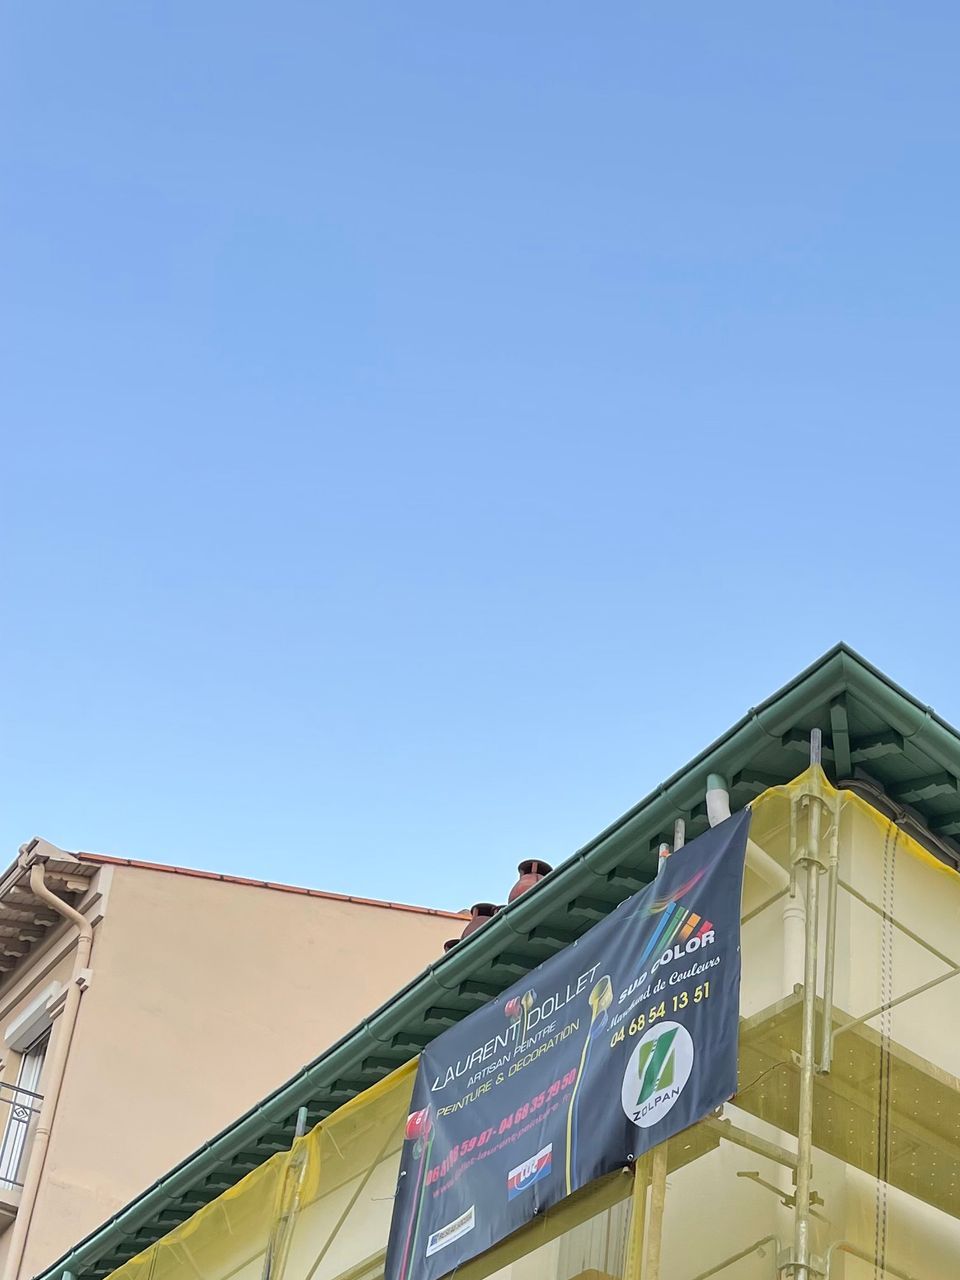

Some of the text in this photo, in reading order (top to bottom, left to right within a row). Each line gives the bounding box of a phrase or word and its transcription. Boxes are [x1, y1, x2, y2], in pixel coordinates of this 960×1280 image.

[618, 930, 715, 1004] SUD COLOR
[653, 979, 666, 995] de
[669, 956, 721, 986] Couleurs
[432, 962, 601, 1091] LAURENT DOLLET
[610, 981, 710, 1047] 04 68 54 13 51
[436, 1019, 580, 1119] PEINTURE & DECORATION
[467, 1020, 557, 1088] ARTISAN PEINTRE
[633, 1087, 681, 1121] ZOLPAN
